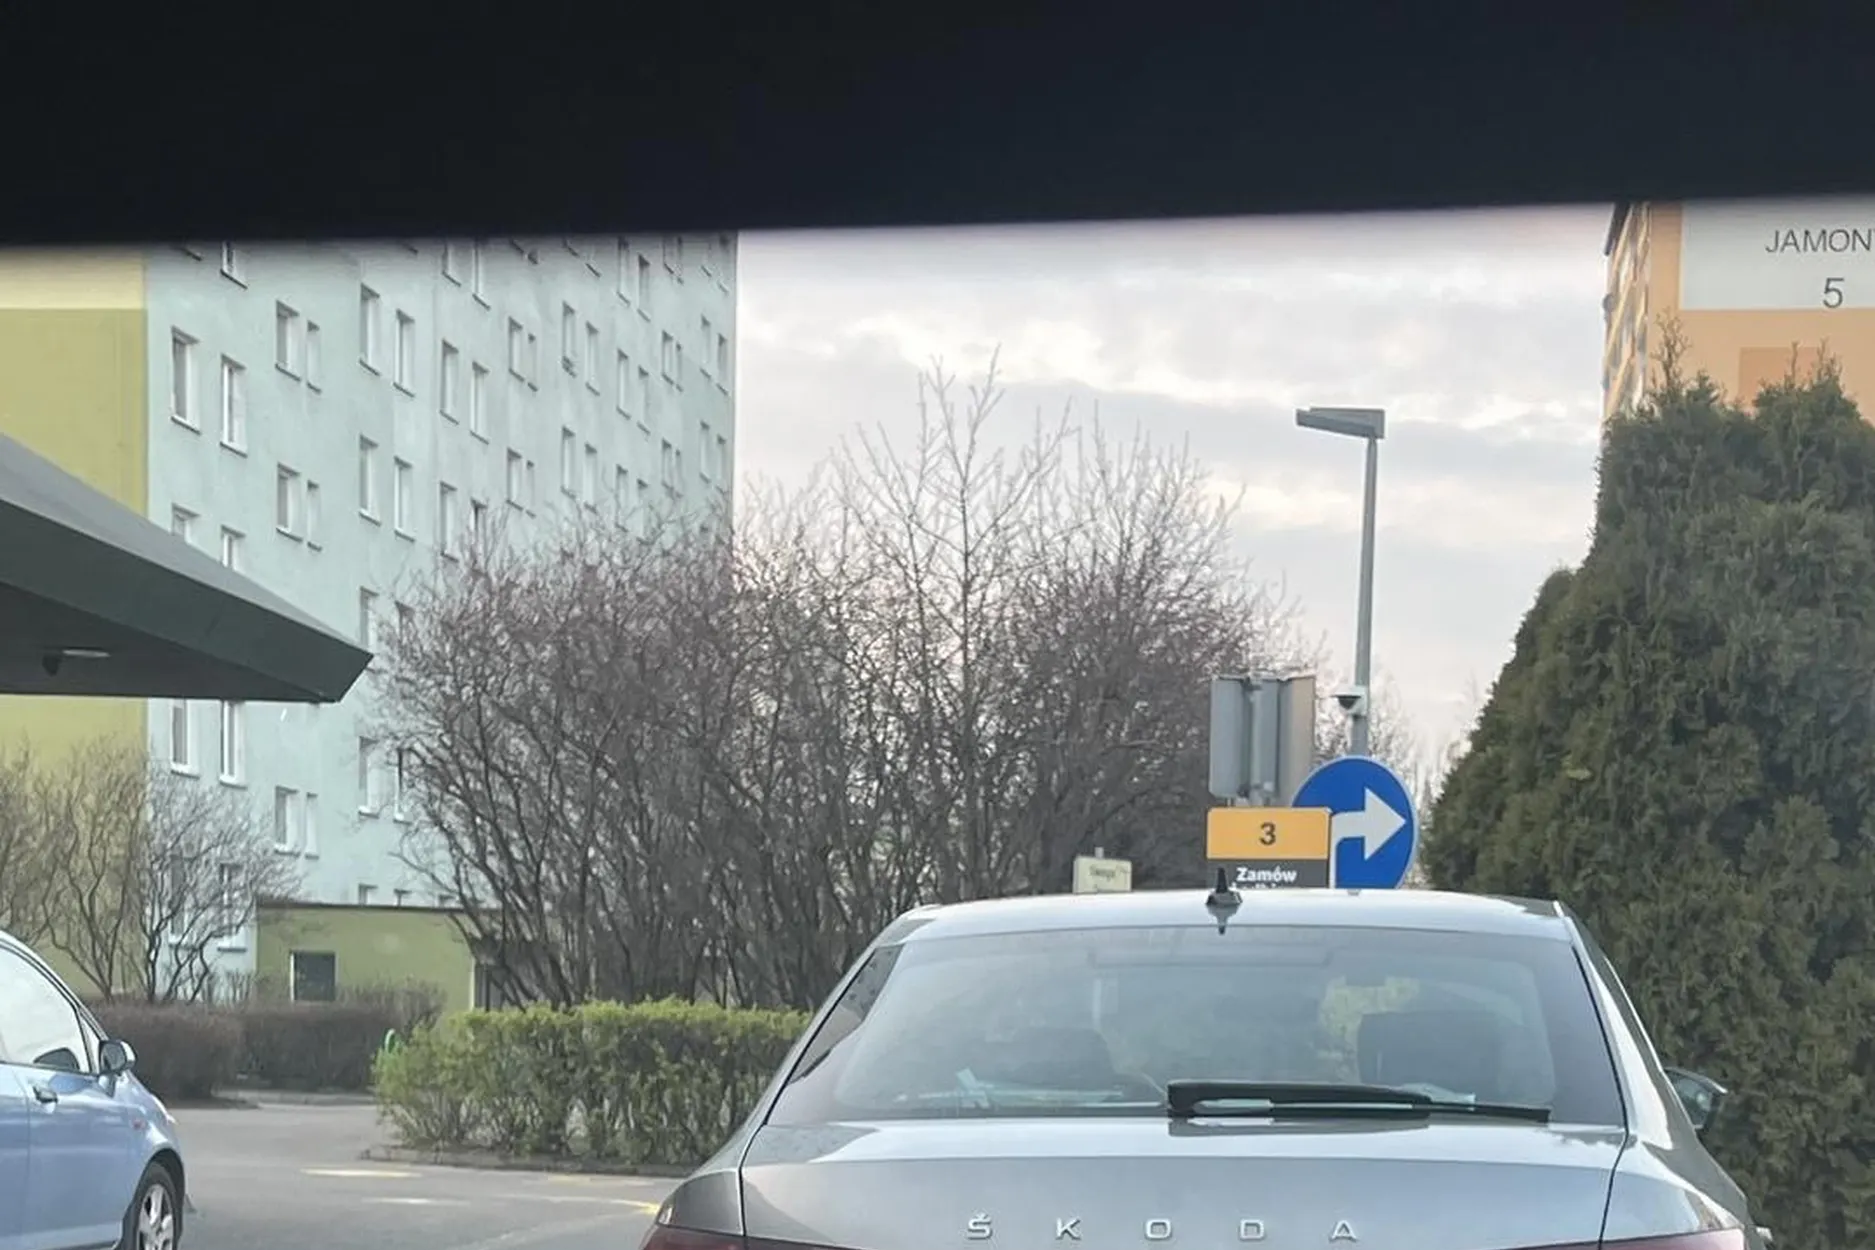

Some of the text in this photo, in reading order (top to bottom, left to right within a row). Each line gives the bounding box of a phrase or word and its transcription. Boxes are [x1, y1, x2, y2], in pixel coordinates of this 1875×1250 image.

[1765, 228, 1875, 253] JAMON
[1822, 277, 1845, 309] 5
[1259, 822, 1276, 846] 3
[1236, 865, 1297, 883] Zamów
